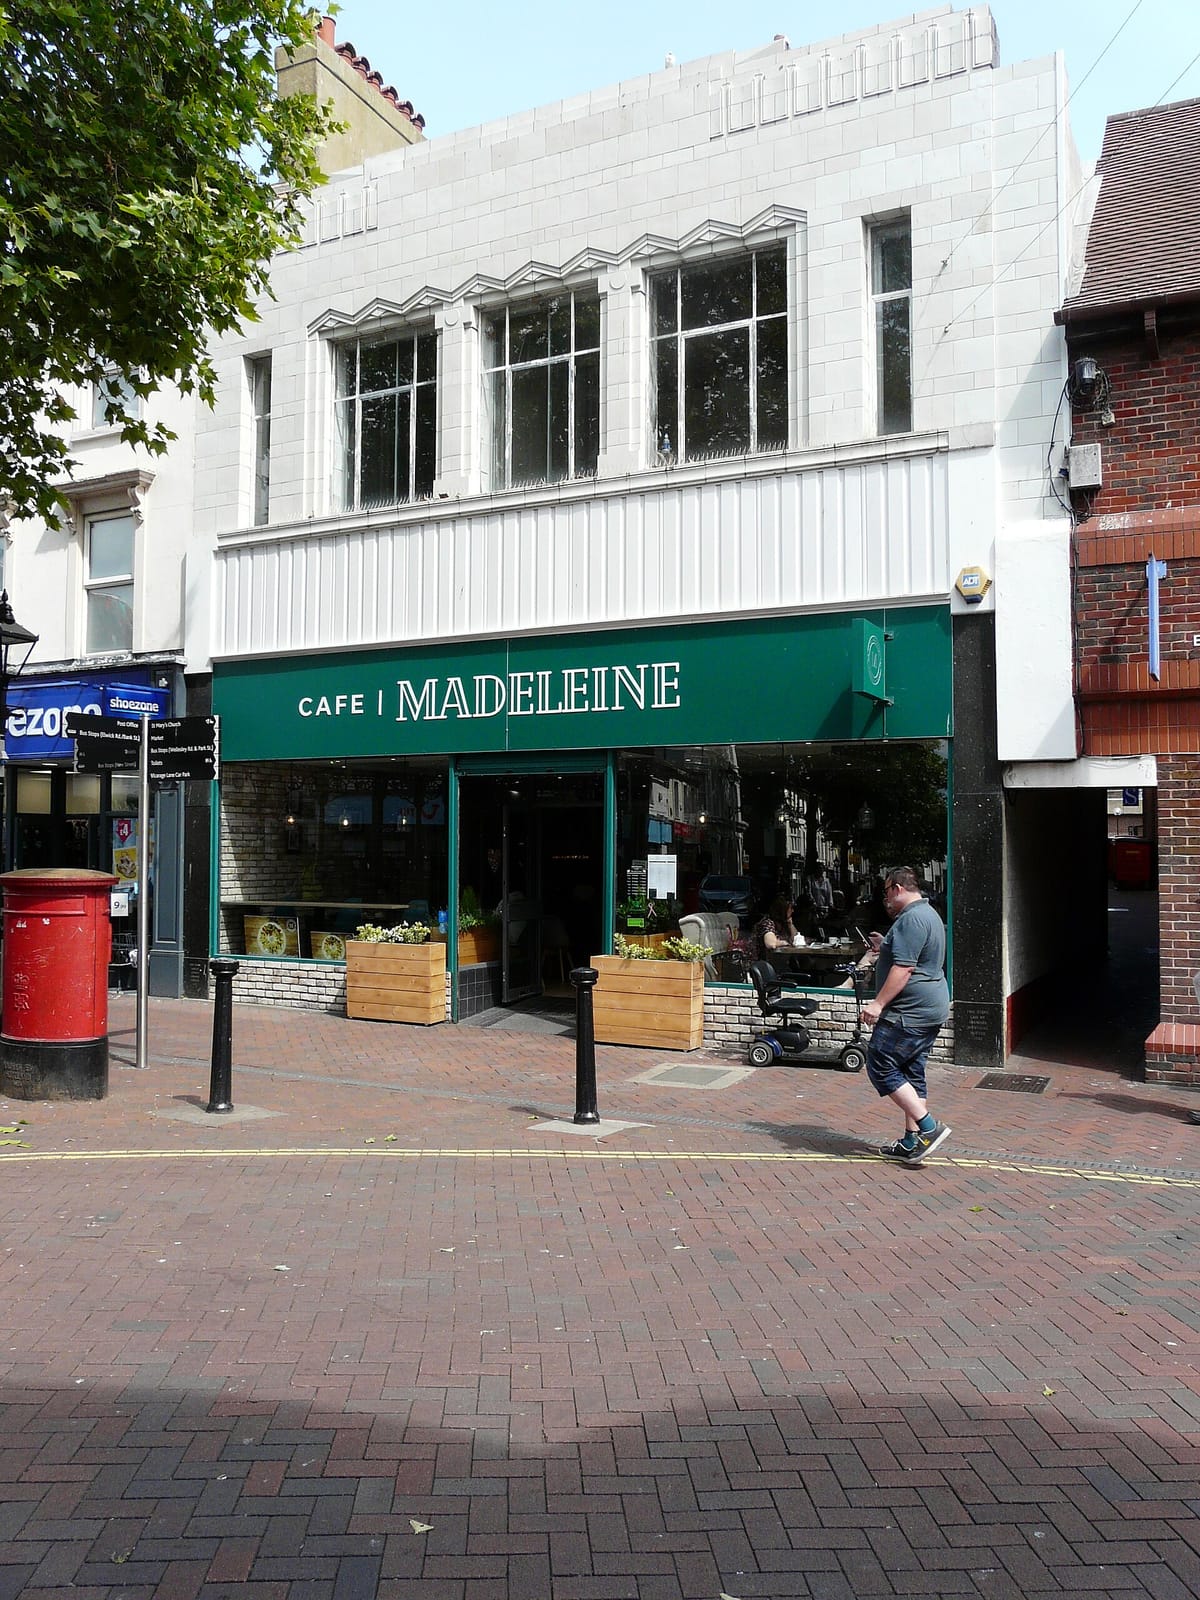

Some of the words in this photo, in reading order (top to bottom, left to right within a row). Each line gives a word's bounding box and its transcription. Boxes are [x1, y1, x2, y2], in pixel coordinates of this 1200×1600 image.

[962, 576, 979, 586] ADT
[298, 694, 364, 718] CAFE
[396, 662, 681, 722] MADELEINE
[110, 696, 159, 712] shoezone
[126, 721, 139, 729] Office
